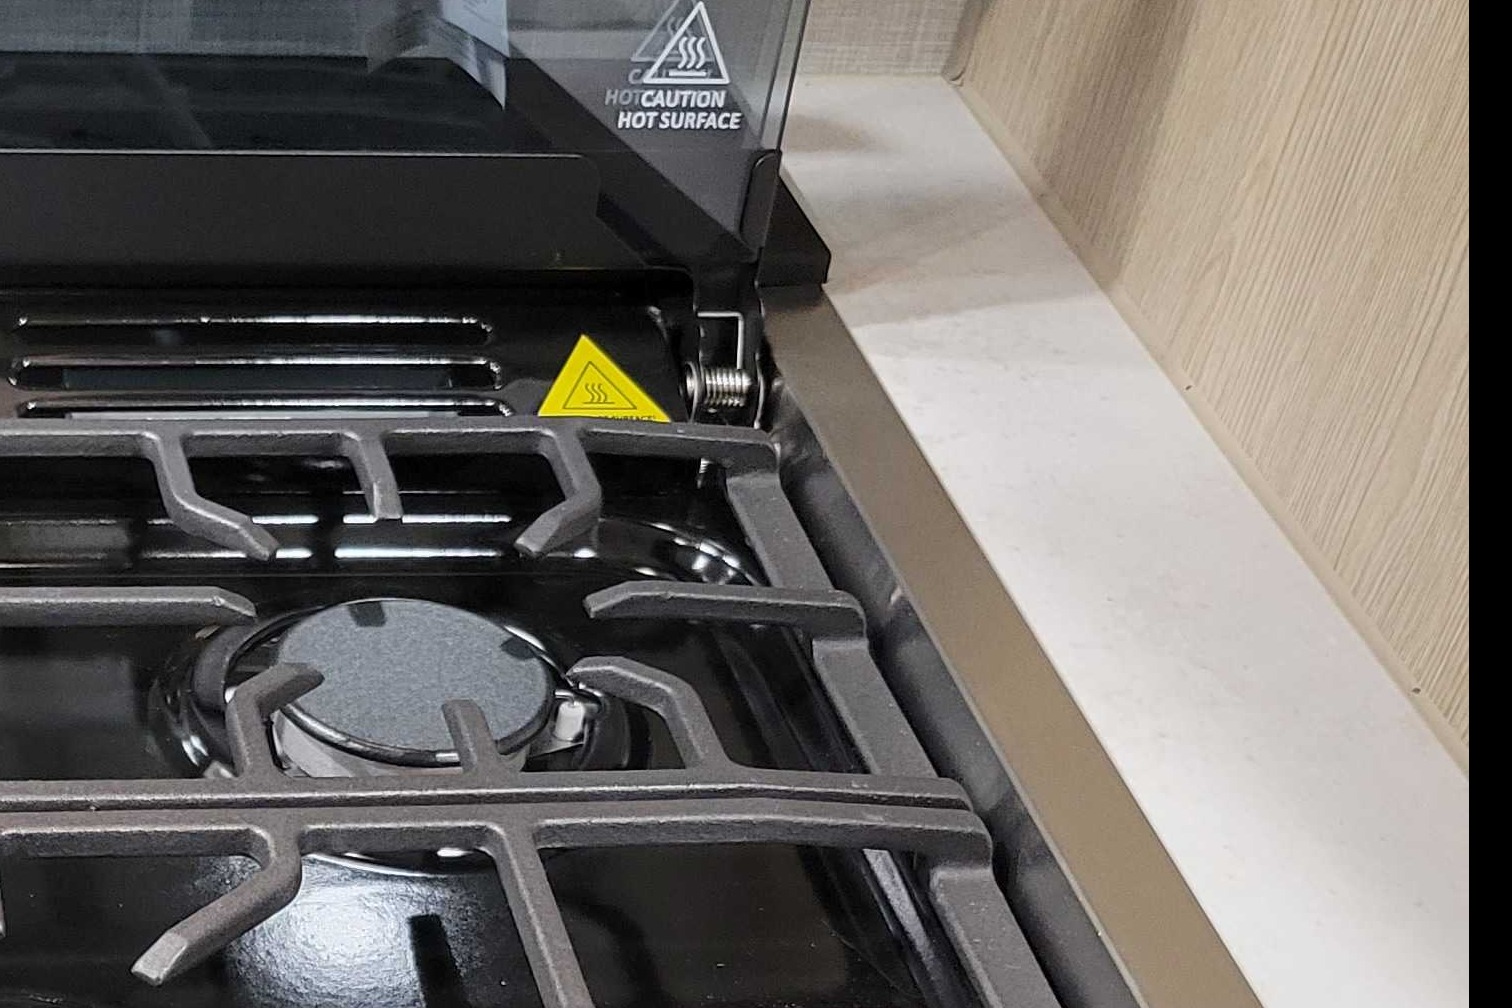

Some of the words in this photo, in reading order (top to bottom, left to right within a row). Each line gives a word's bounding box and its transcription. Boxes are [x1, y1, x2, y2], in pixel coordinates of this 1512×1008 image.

[640, 89, 726, 108] CAUTION
[617, 111, 660, 129] HOT
[660, 111, 742, 130] SURFACE
